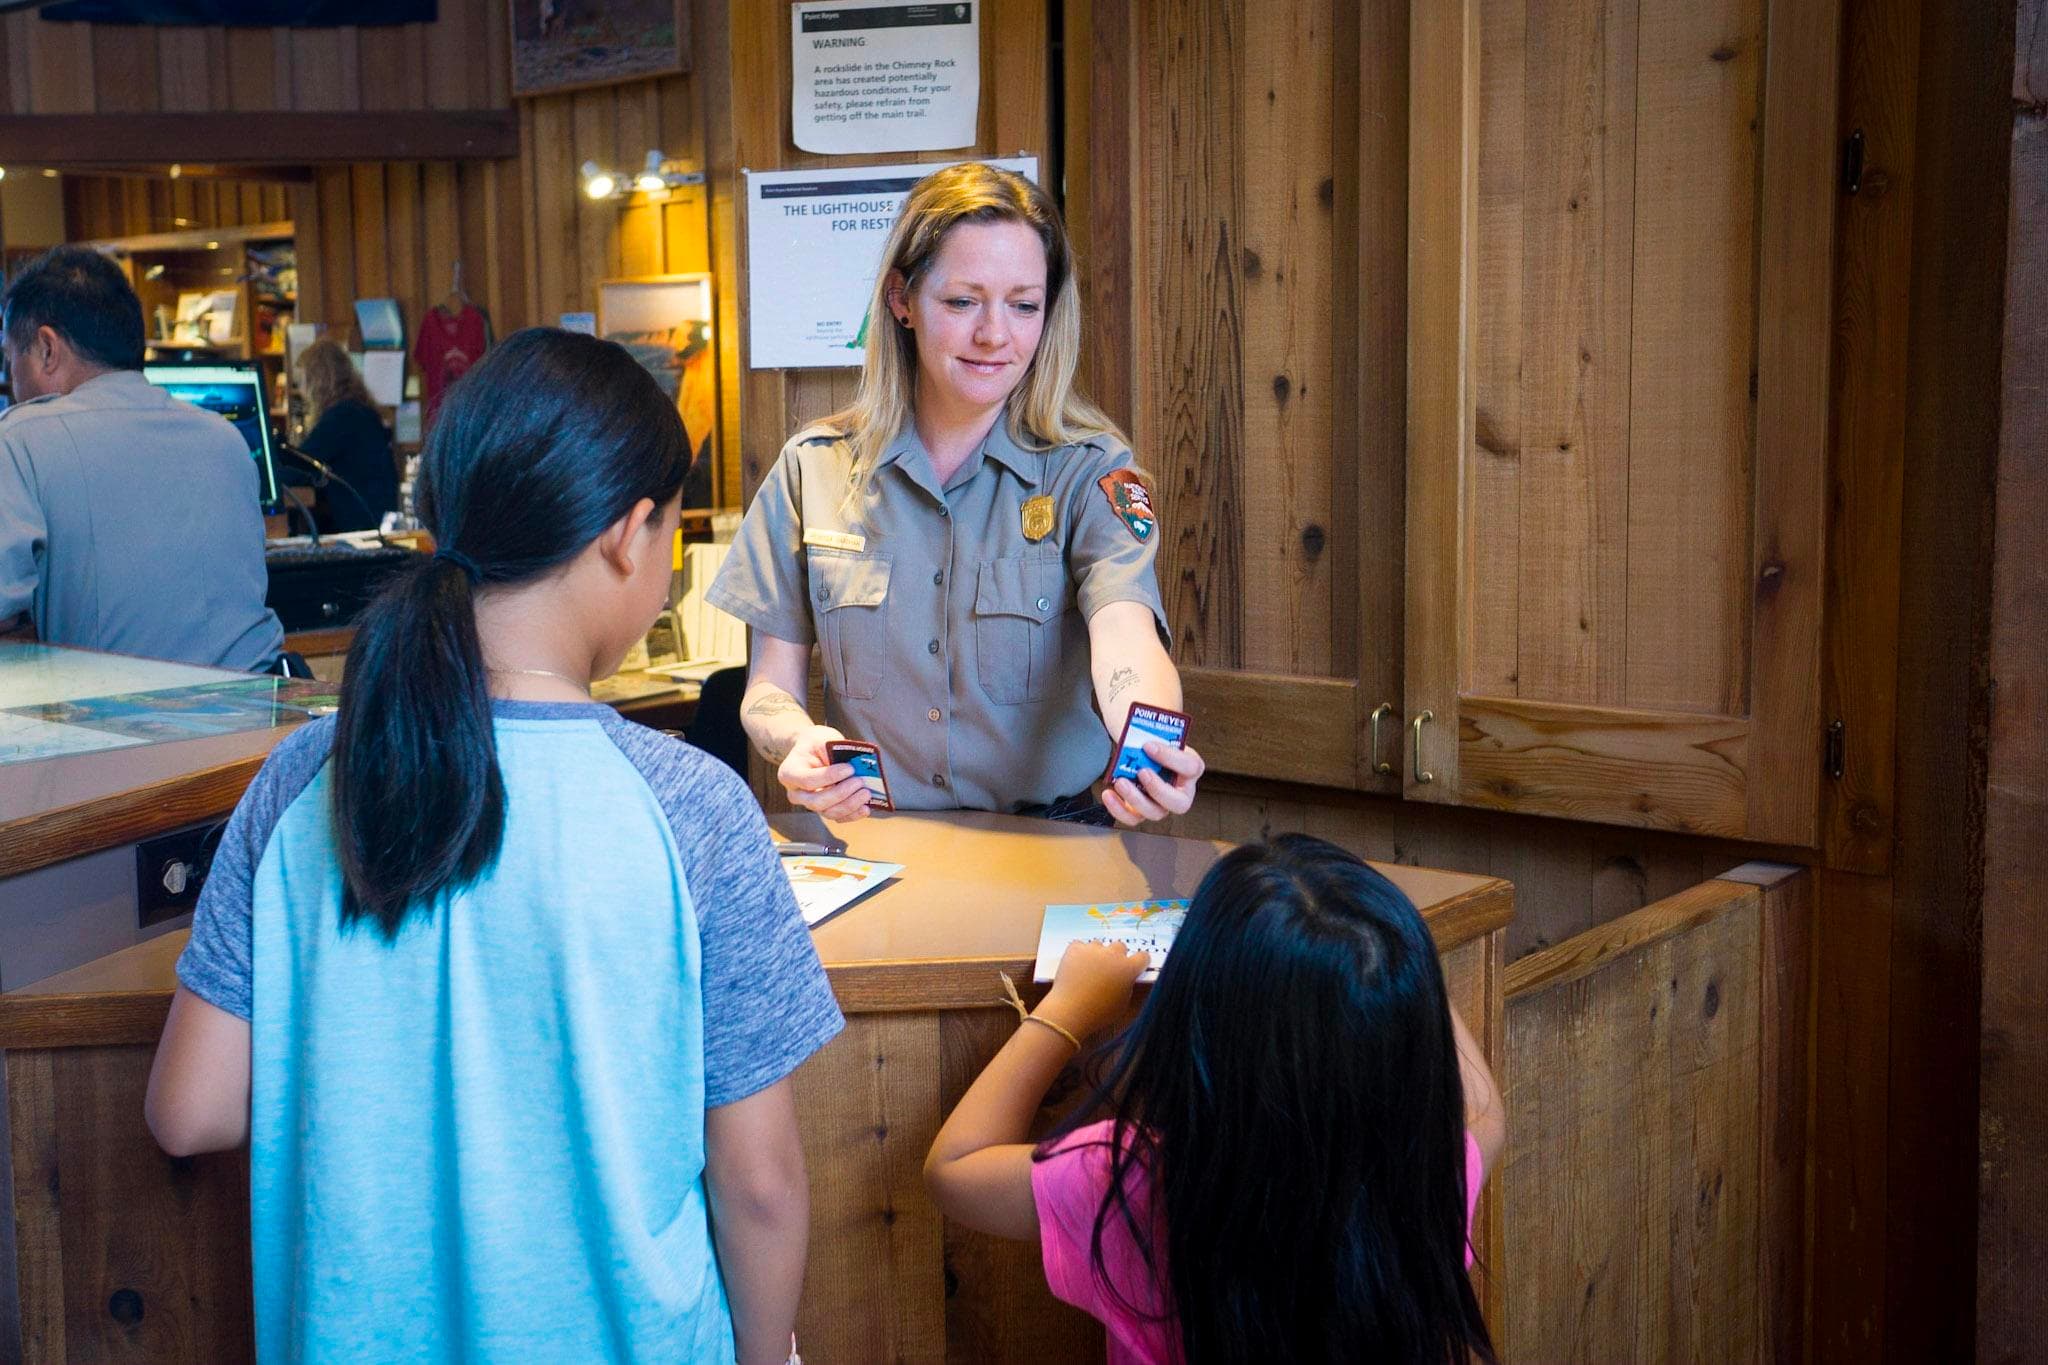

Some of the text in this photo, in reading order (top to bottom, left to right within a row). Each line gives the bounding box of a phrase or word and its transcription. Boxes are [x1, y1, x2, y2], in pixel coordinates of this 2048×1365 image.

[821, 12, 840, 20] Reyes
[812, 37, 866, 49] WARNING
[824, 63, 862, 73] rockslide
[864, 62, 873, 70] in
[875, 62, 890, 70] the
[892, 60, 932, 70] Chimney
[934, 59, 956, 68] Rock
[836, 76, 850, 84] has
[853, 74, 886, 84] created
[888, 72, 938, 84] potentially
[814, 84, 952, 98] hazardous conditions. For your
[814, 96, 930, 110] safety, please refrain from
[814, 108, 927, 124] getting off the main trail.
[784, 204, 808, 216] THE
[812, 200, 894, 215] LIGHTHOUSE
[832, 218, 893, 232] FOR REST
[1134, 708, 1186, 728] POINT REYES
